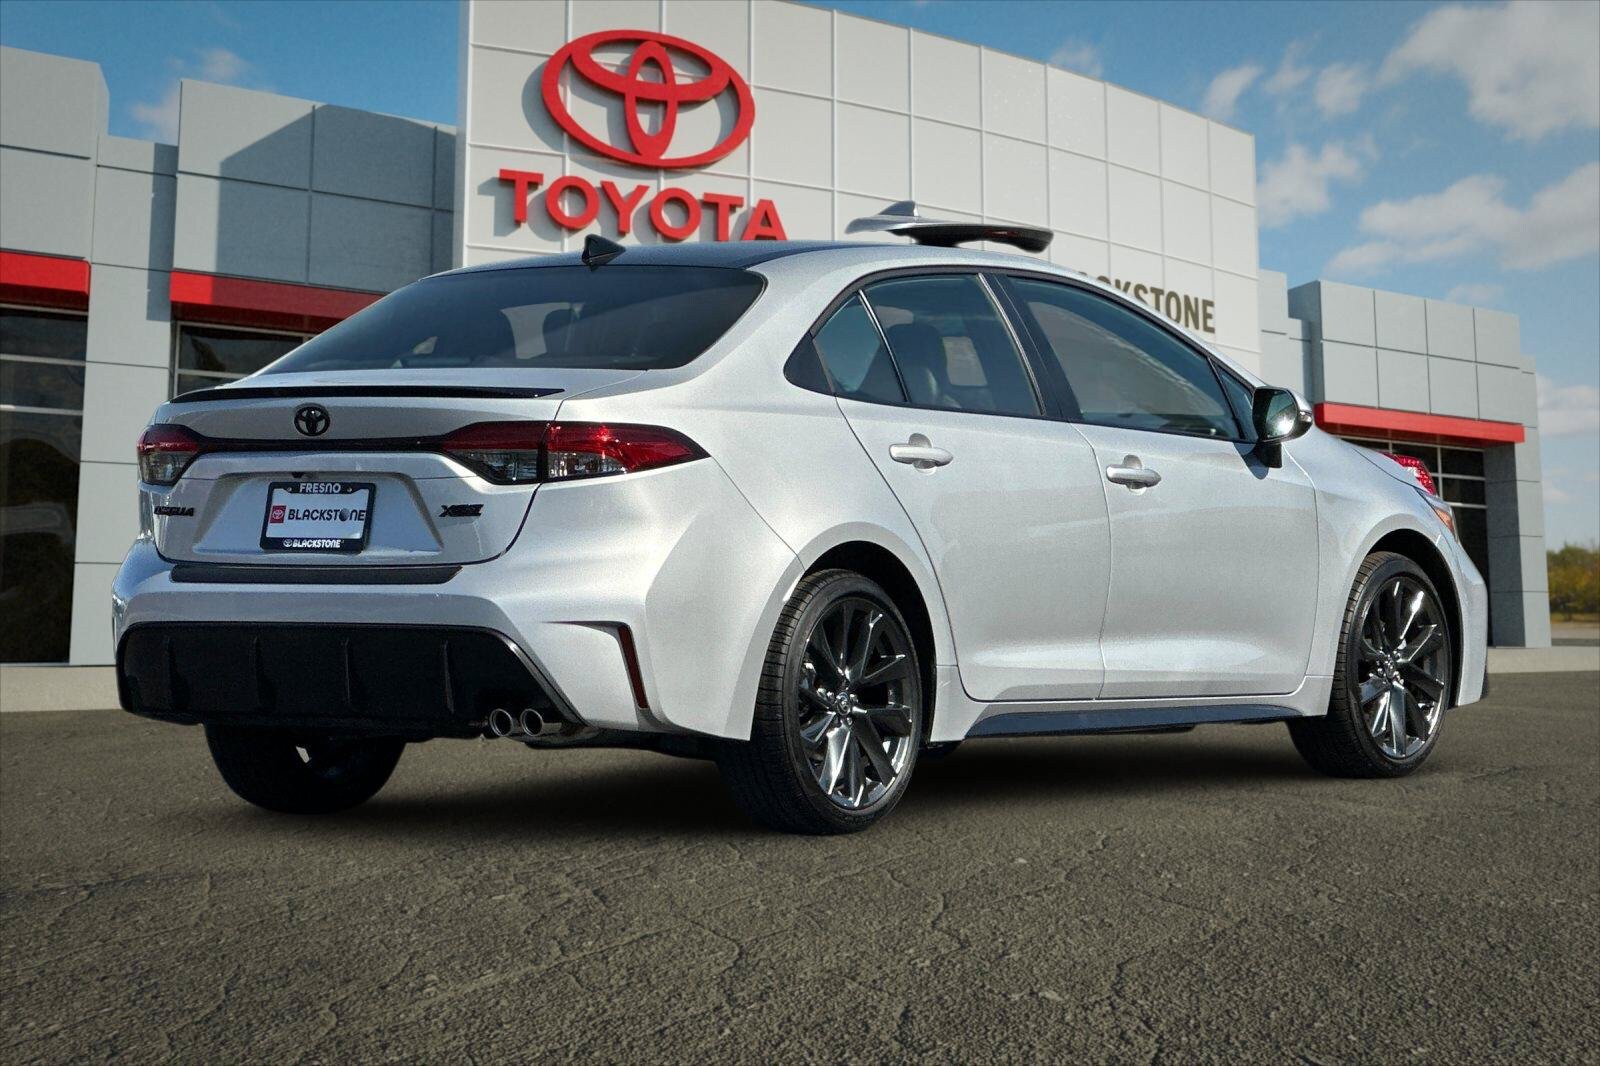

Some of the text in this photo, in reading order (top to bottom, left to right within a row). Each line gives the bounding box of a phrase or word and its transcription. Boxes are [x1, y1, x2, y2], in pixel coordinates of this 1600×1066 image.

[498, 168, 788, 241] TOYOTA
[299, 482, 341, 493] FRESNO
[287, 508, 366, 521] BLACKSTONE
[292, 539, 341, 548] BLACKSTONE
